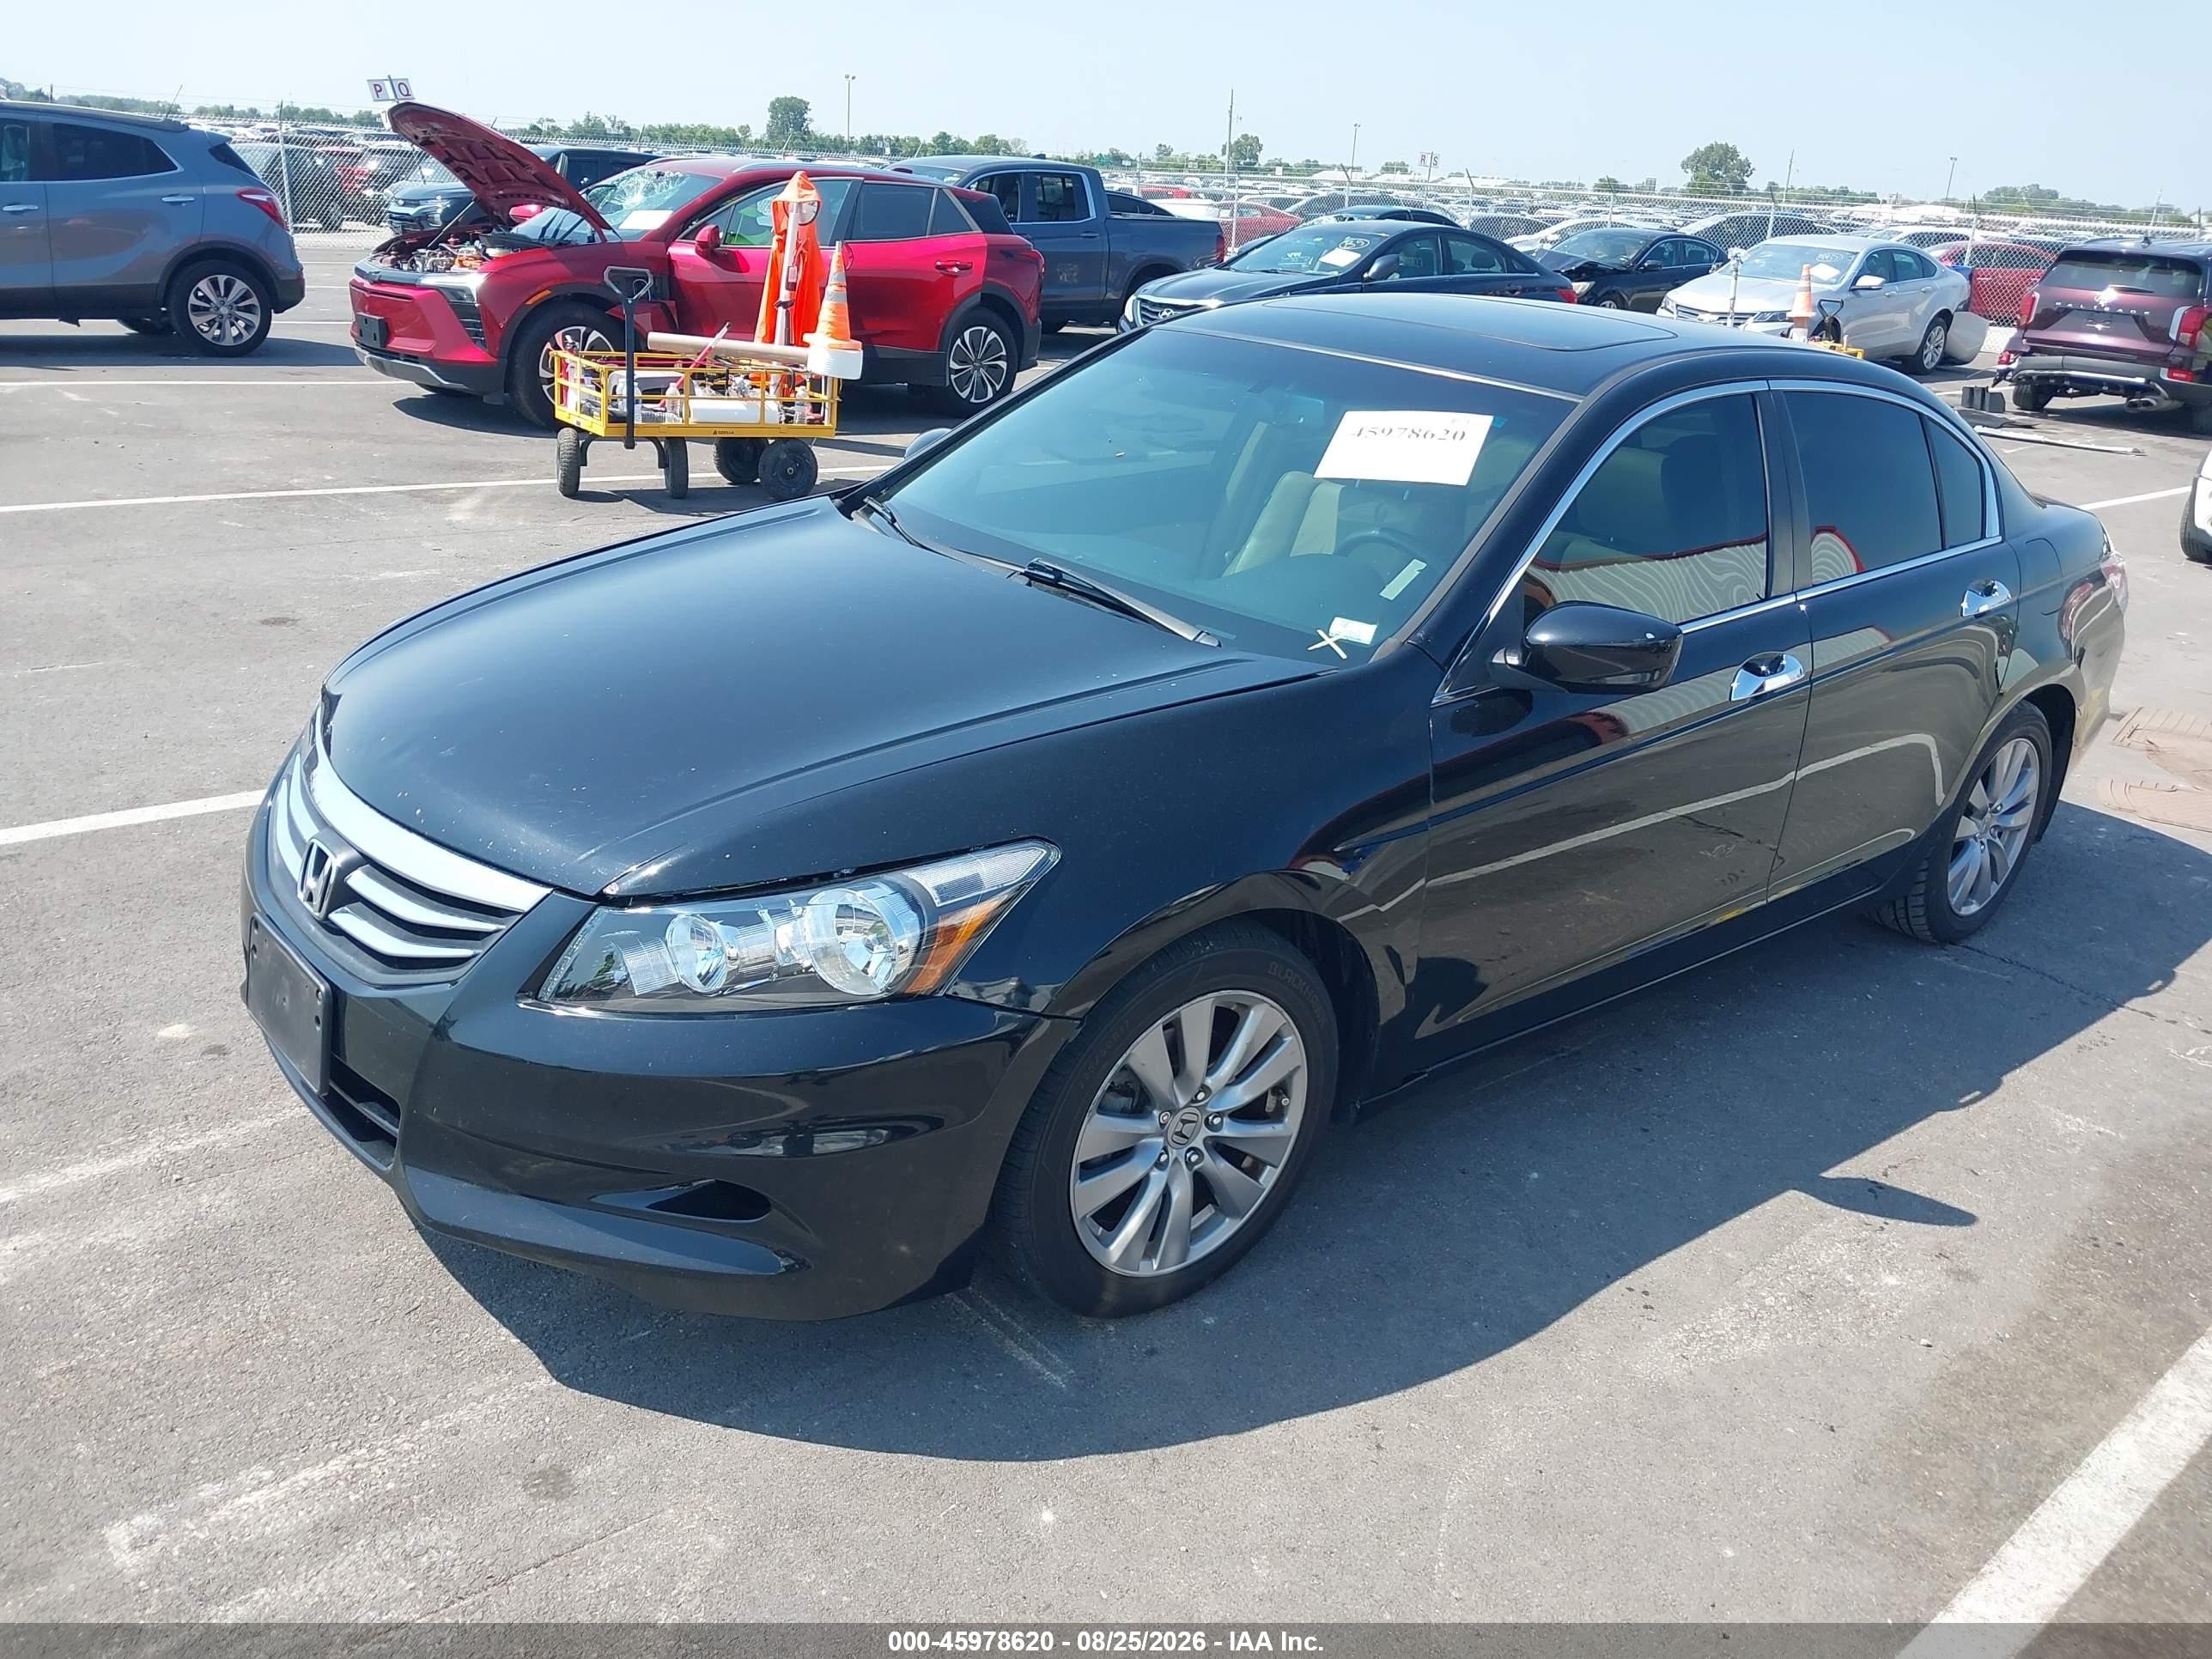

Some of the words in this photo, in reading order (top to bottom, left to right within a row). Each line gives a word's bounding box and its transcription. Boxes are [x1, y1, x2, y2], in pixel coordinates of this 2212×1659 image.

[374, 83, 383, 99] P
[398, 82, 412, 97] Q
[1420, 155, 1426, 164] R
[1432, 156, 1438, 166] S
[1350, 427, 1467, 441] 45978620
